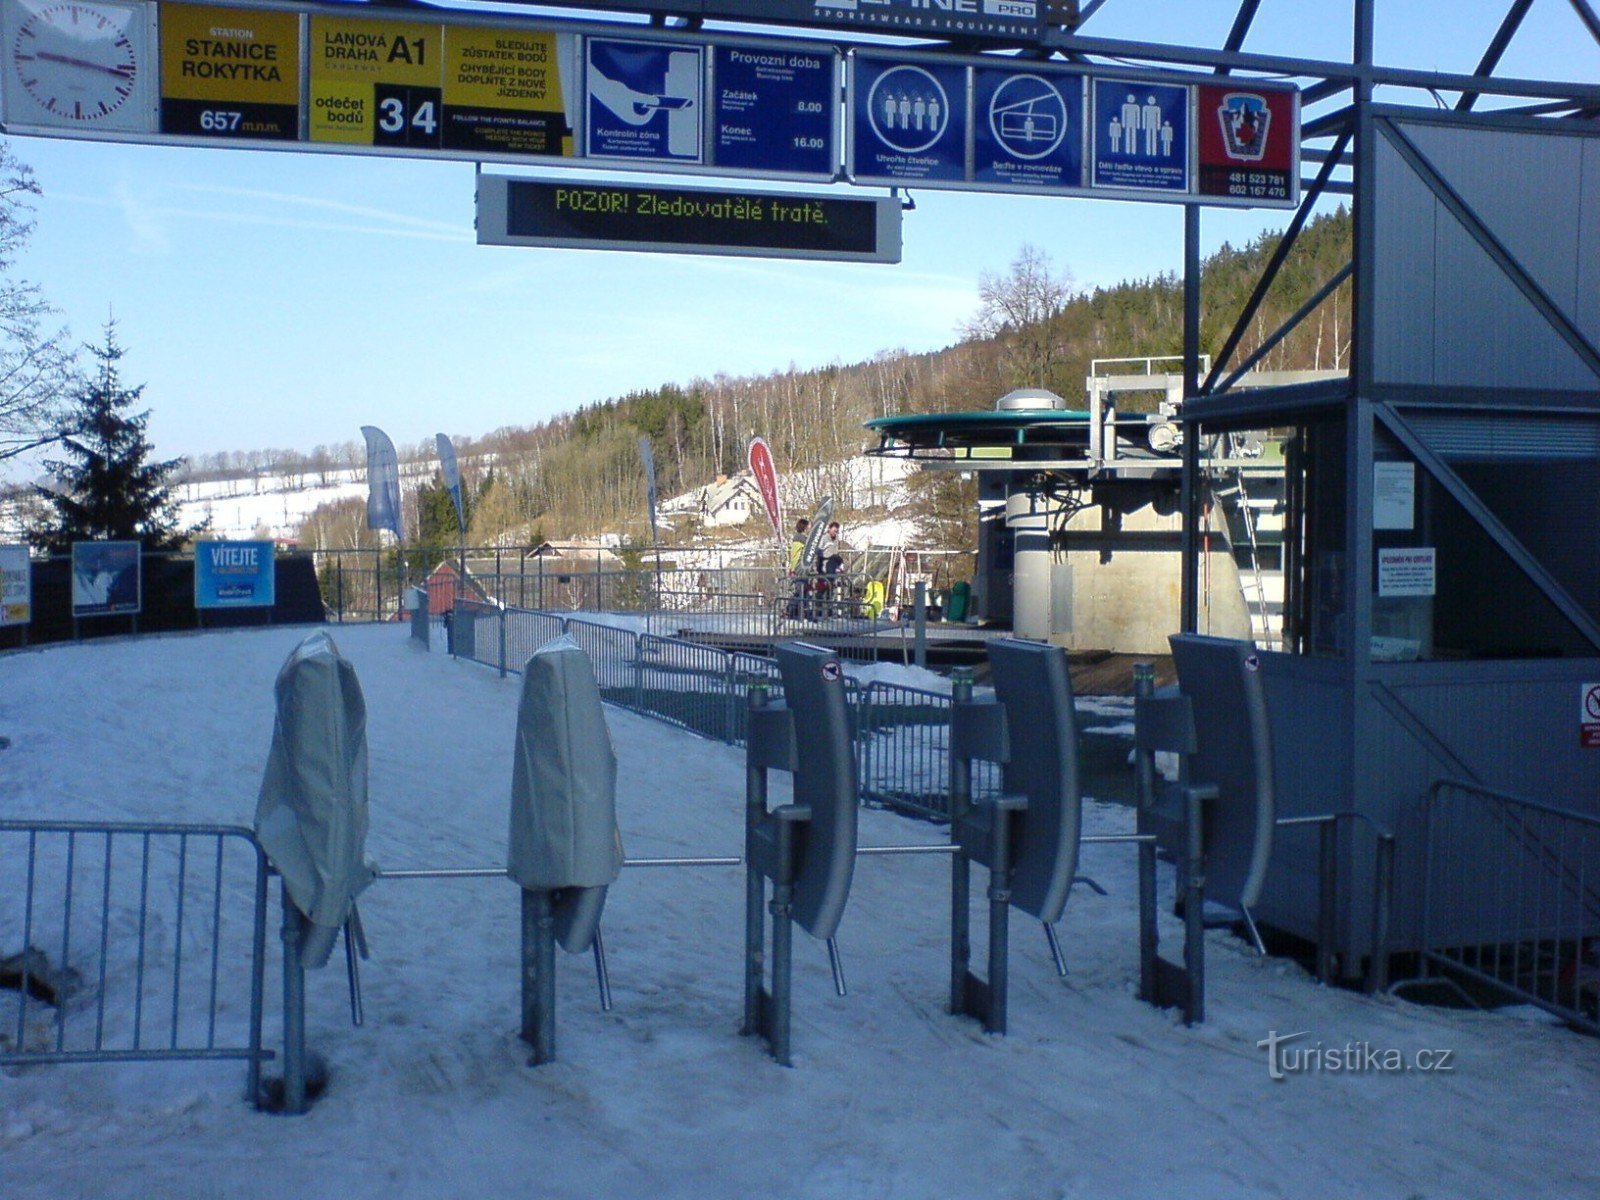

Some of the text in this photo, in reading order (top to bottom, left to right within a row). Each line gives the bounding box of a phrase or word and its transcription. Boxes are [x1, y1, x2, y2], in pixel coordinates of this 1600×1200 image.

[998, 4, 1034, 15] PRO
[814, 9, 922, 25] SPORTSWEAR
[946, 20, 1038, 35] EQUIPMENT
[210, 27, 254, 38] STATION
[325, 31, 387, 47] LANOVÁ
[186, 38, 277, 60] STANICE
[387, 35, 426, 66] A1
[496, 39, 547, 52] SLEDUJTE
[325, 44, 378, 61] DRÁHA
[462, 47, 547, 62] ZŮSTATEK BODŮ
[730, 51, 820, 69] Provozní doba
[182, 60, 281, 82] ROKYTKA
[518, 67, 546, 77] BODY
[510, 78, 516, 86] Z
[497, 86, 546, 99] JÍZDENKY
[722, 89, 758, 100] Začátek
[315, 96, 364, 110] odečet
[798, 101, 822, 113] 8.00
[200, 110, 242, 130] 657
[328, 110, 364, 123] bodů
[721, 125, 752, 135] Konec
[793, 137, 824, 148] 16.00
[1249, 173, 1266, 185] 523
[1268, 175, 1285, 186] 781
[1229, 185, 1286, 197] 602 167 470
[556, 189, 828, 224] POZOR! Zledovatělé tratě.
[211, 543, 259, 567] VÍTEJTE
